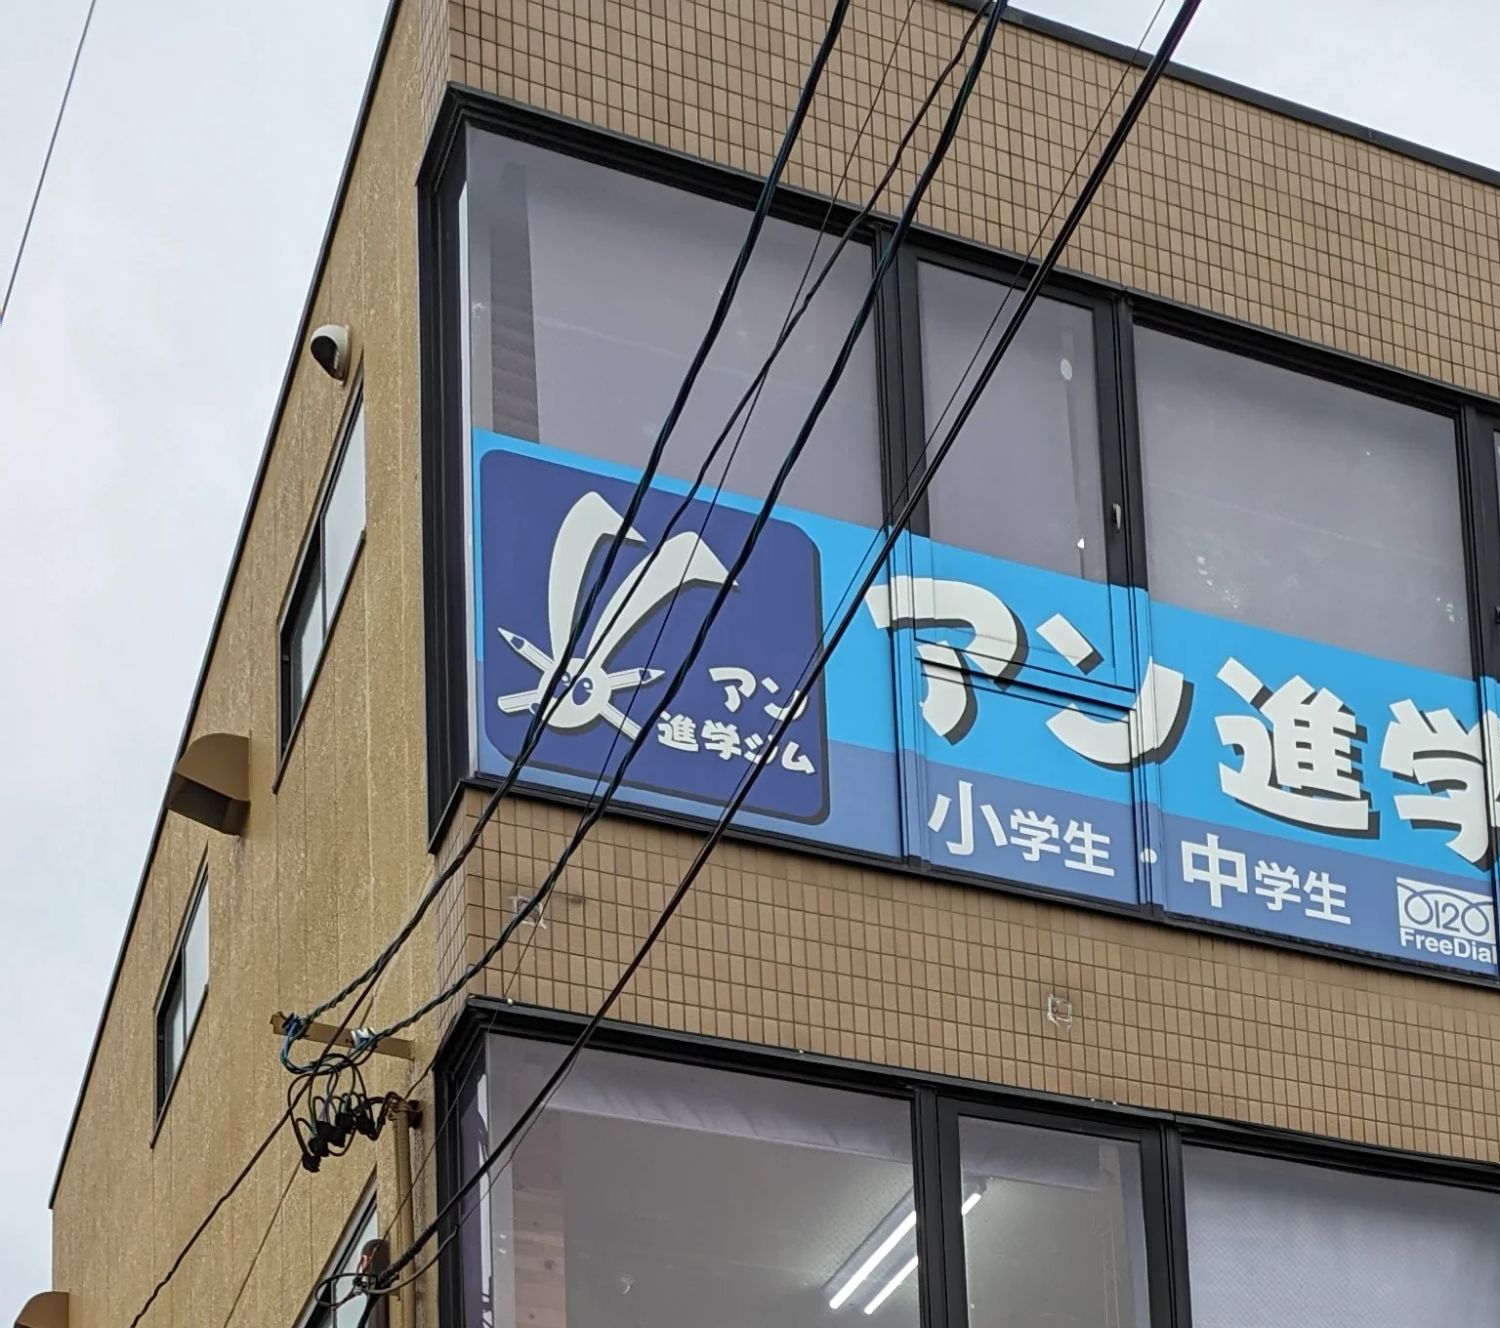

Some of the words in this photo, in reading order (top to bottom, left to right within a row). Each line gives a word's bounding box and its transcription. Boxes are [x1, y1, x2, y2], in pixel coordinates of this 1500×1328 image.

[708, 666, 811, 722] アン
[657, 712, 816, 776] 進学ジム
[1399, 926, 1498, 965] FreeDial
